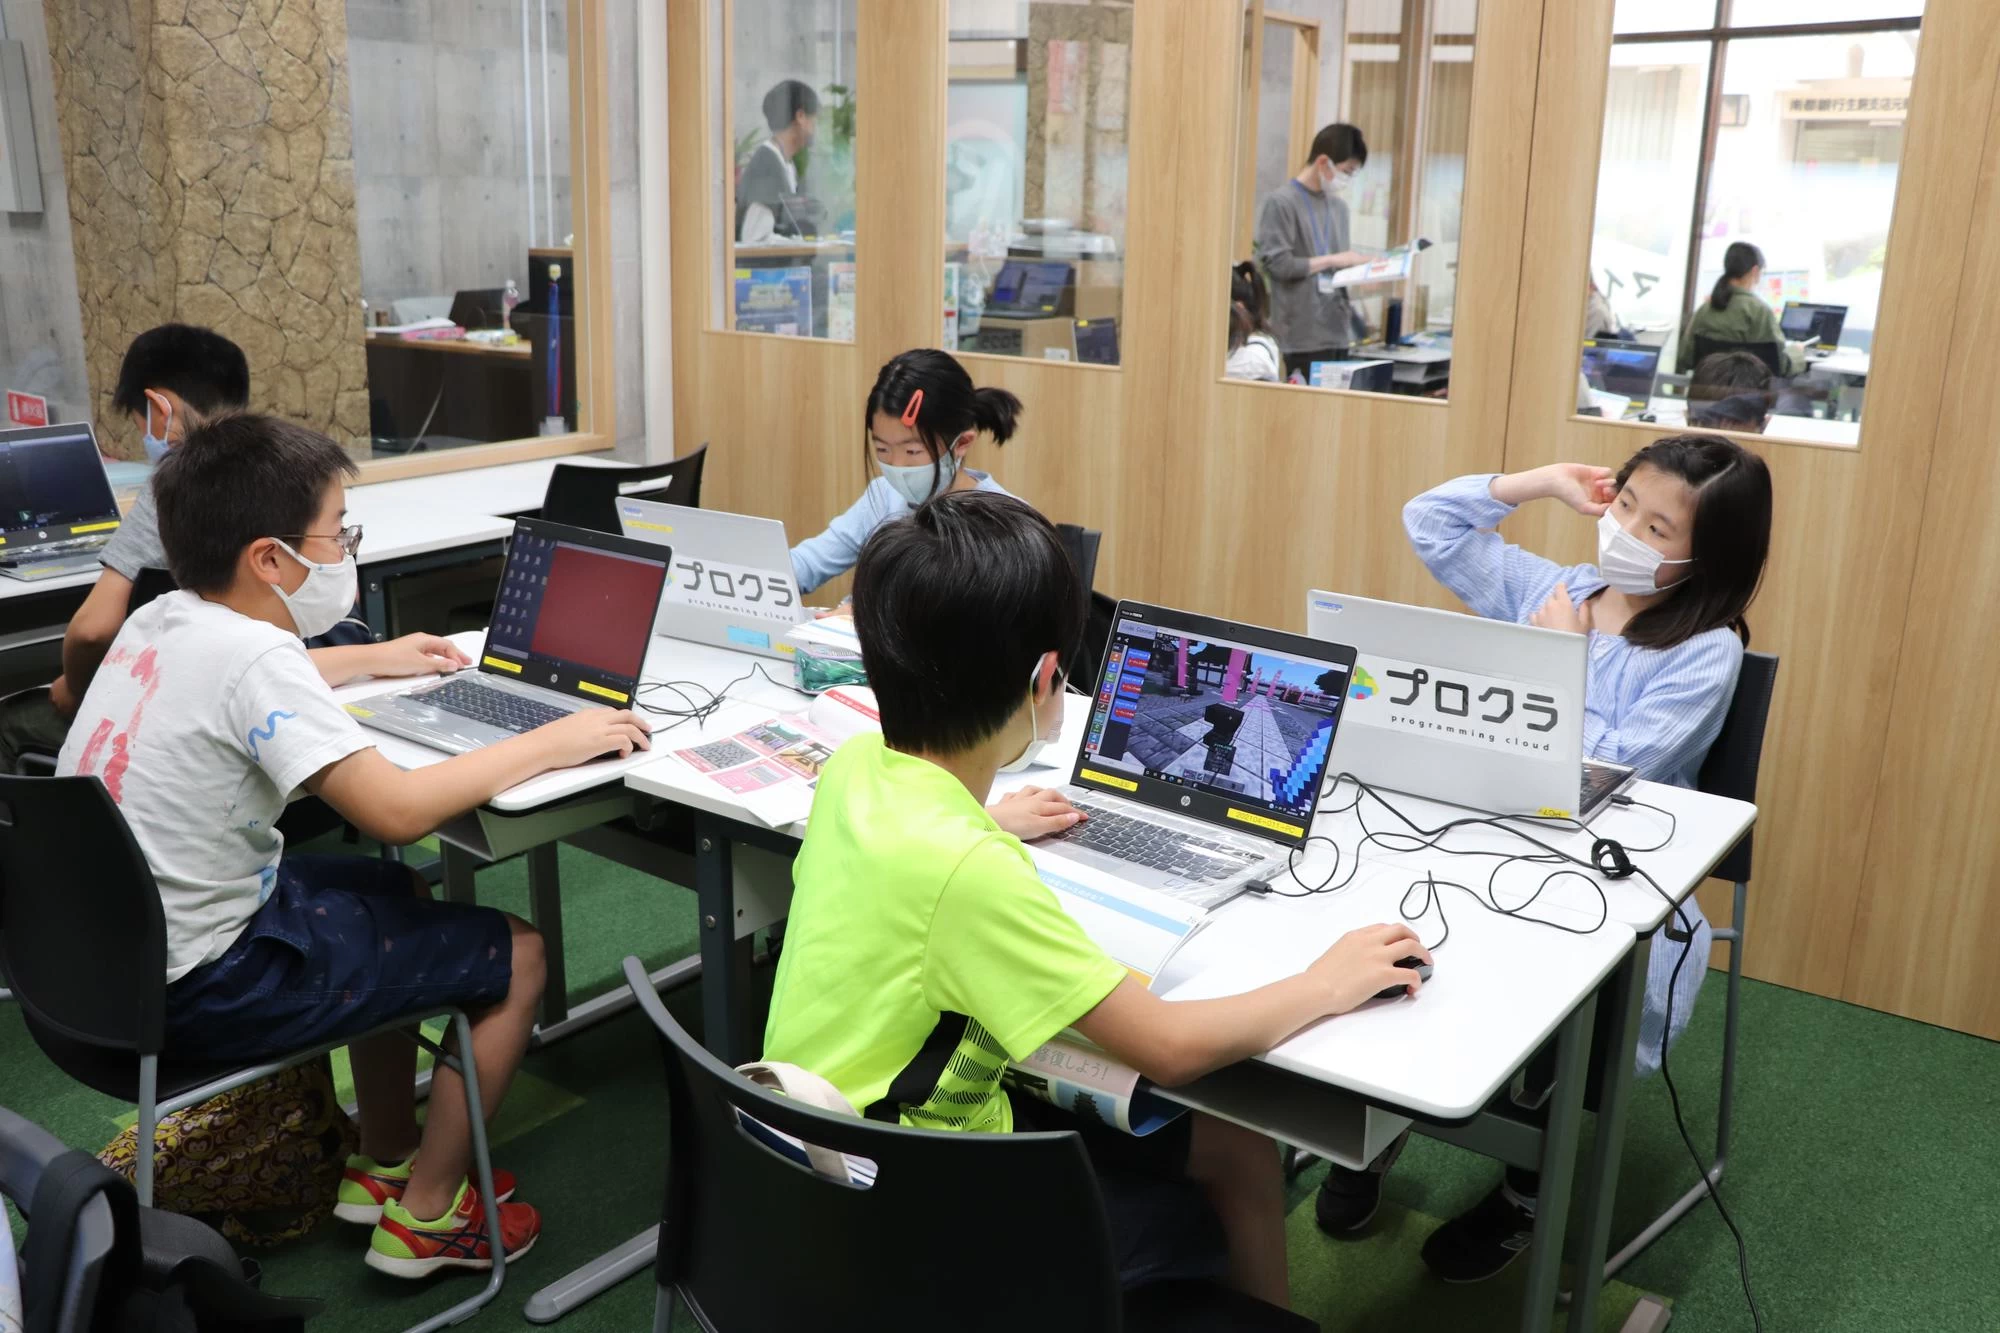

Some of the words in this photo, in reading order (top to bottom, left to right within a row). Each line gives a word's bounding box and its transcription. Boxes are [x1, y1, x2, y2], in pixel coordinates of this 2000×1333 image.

[676, 561, 794, 607] プロクラ
[688, 598, 758, 616] programming
[764, 611, 794, 622] cloud
[1386, 668, 1559, 732] プロクラ
[1391, 714, 1495, 743] programming
[1505, 736, 1550, 751] cloud
